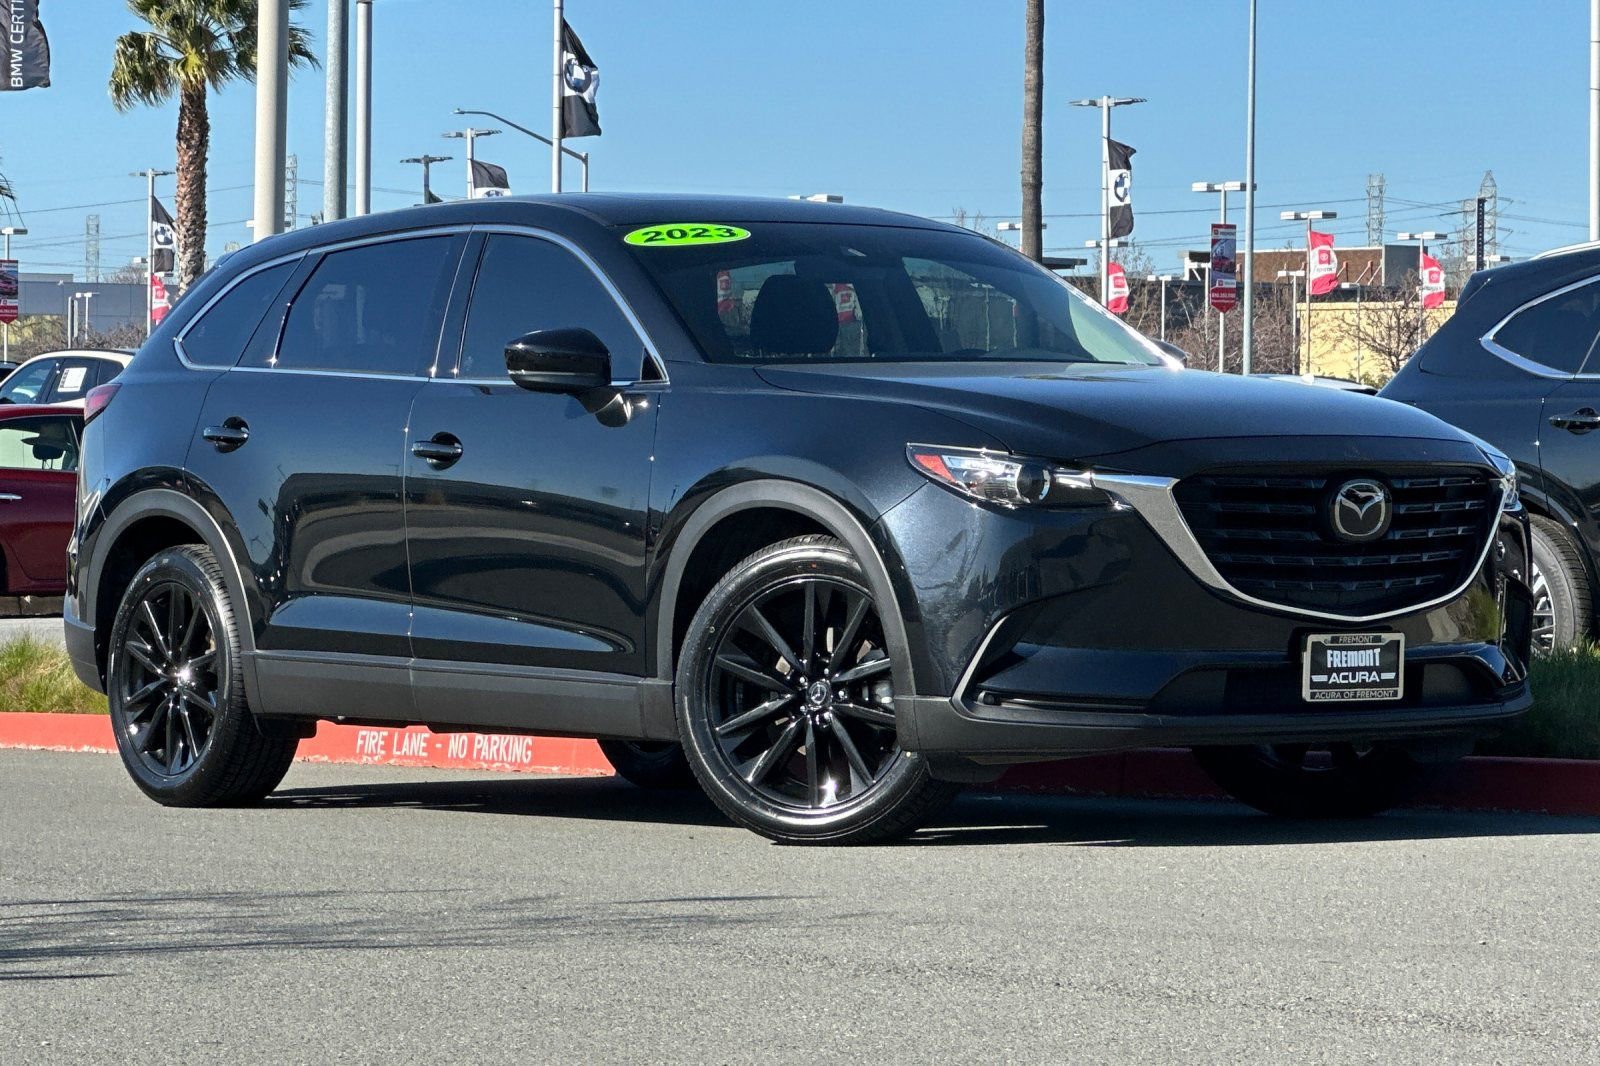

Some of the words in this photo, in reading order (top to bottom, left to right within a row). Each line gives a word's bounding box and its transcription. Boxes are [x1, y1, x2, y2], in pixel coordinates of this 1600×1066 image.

[10, 48, 24, 88] BMW
[641, 227, 738, 243] 2023
[1338, 635, 1374, 644] FREMONT
[1326, 648, 1381, 668] FREMONT
[1328, 671, 1380, 684] ACURA
[1314, 691, 1341, 700] ACURA
[1343, 690, 1355, 699] OF
[1356, 690, 1395, 699] FREMONT
[356, 730, 389, 755] FIRE
[392, 732, 430, 757] LANE
[447, 734, 468, 759] NO
[473, 735, 533, 764] PARKING
